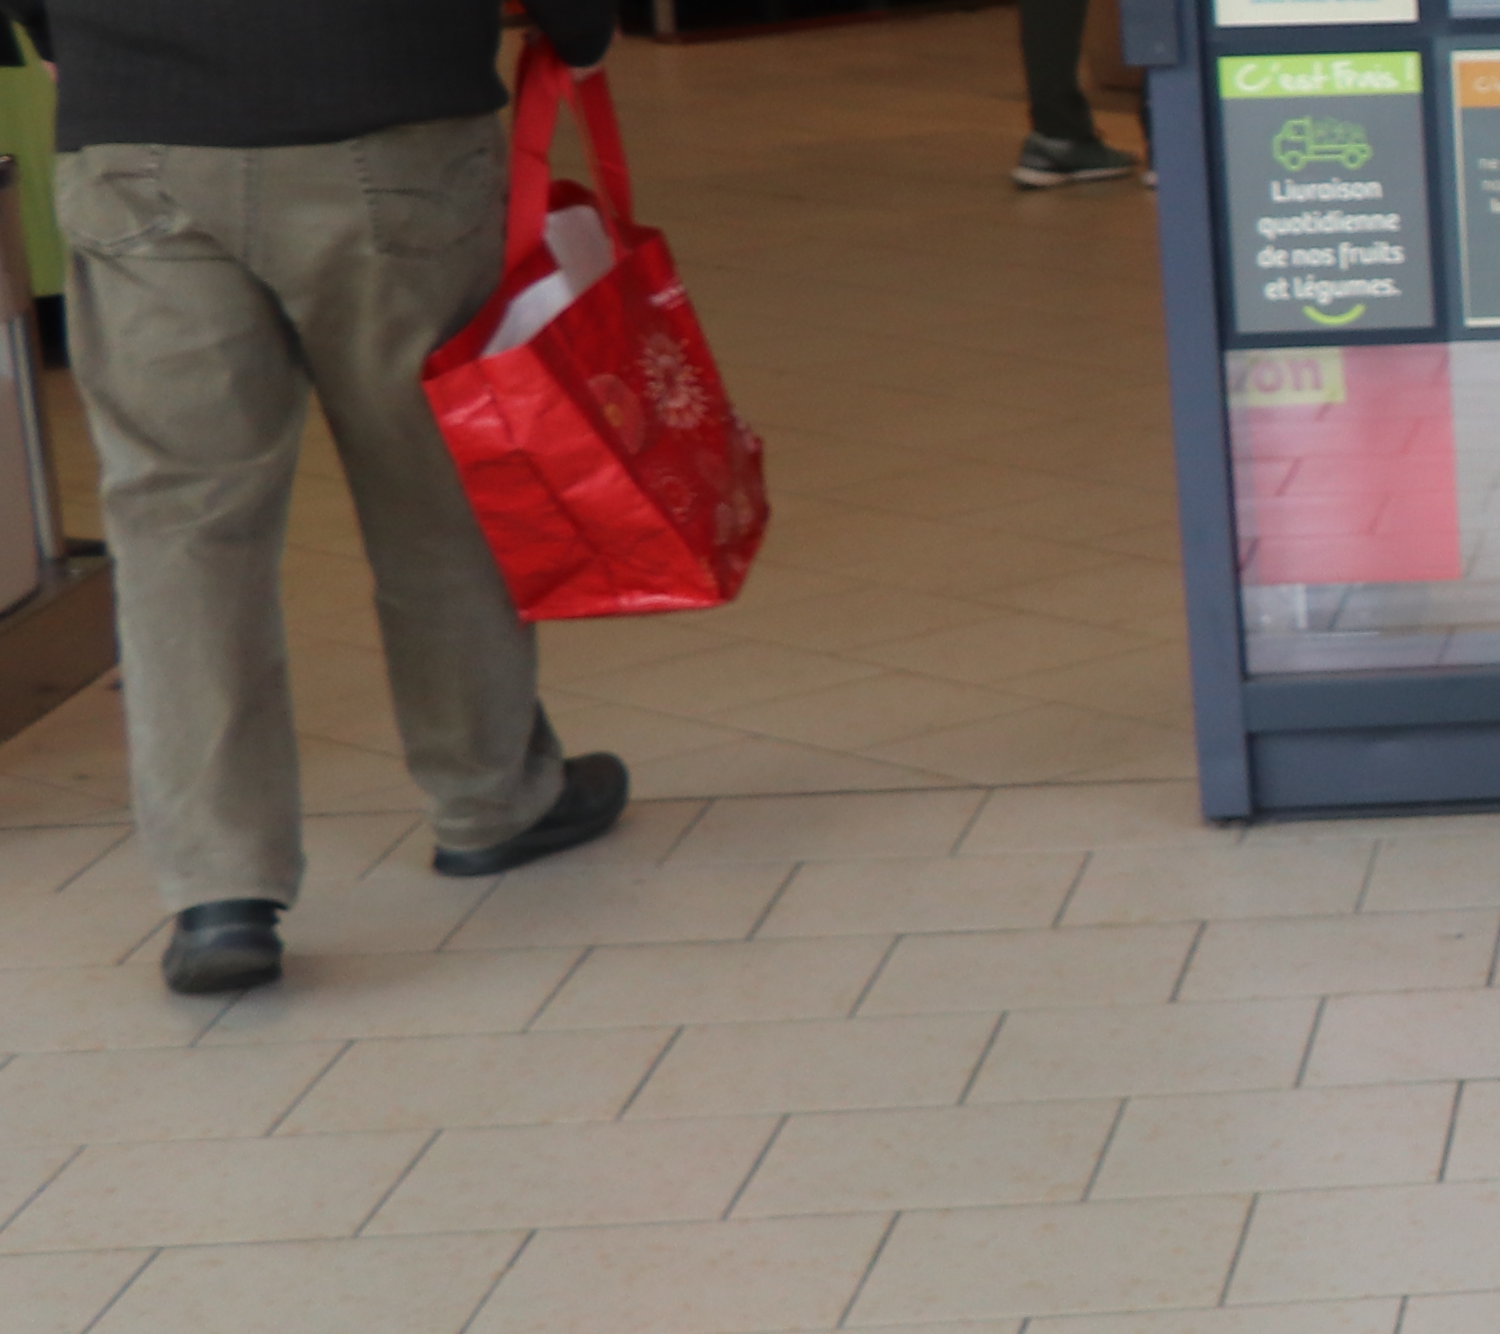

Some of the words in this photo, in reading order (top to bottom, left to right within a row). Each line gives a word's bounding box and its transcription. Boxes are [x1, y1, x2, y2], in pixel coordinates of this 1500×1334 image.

[1269, 176, 1384, 203] Livraison
[1256, 209, 1401, 240] quotidienne
[1256, 244, 1289, 268] de
[1291, 248, 1337, 266] nos
[1338, 241, 1405, 271] fruits
[1264, 277, 1291, 301] et
